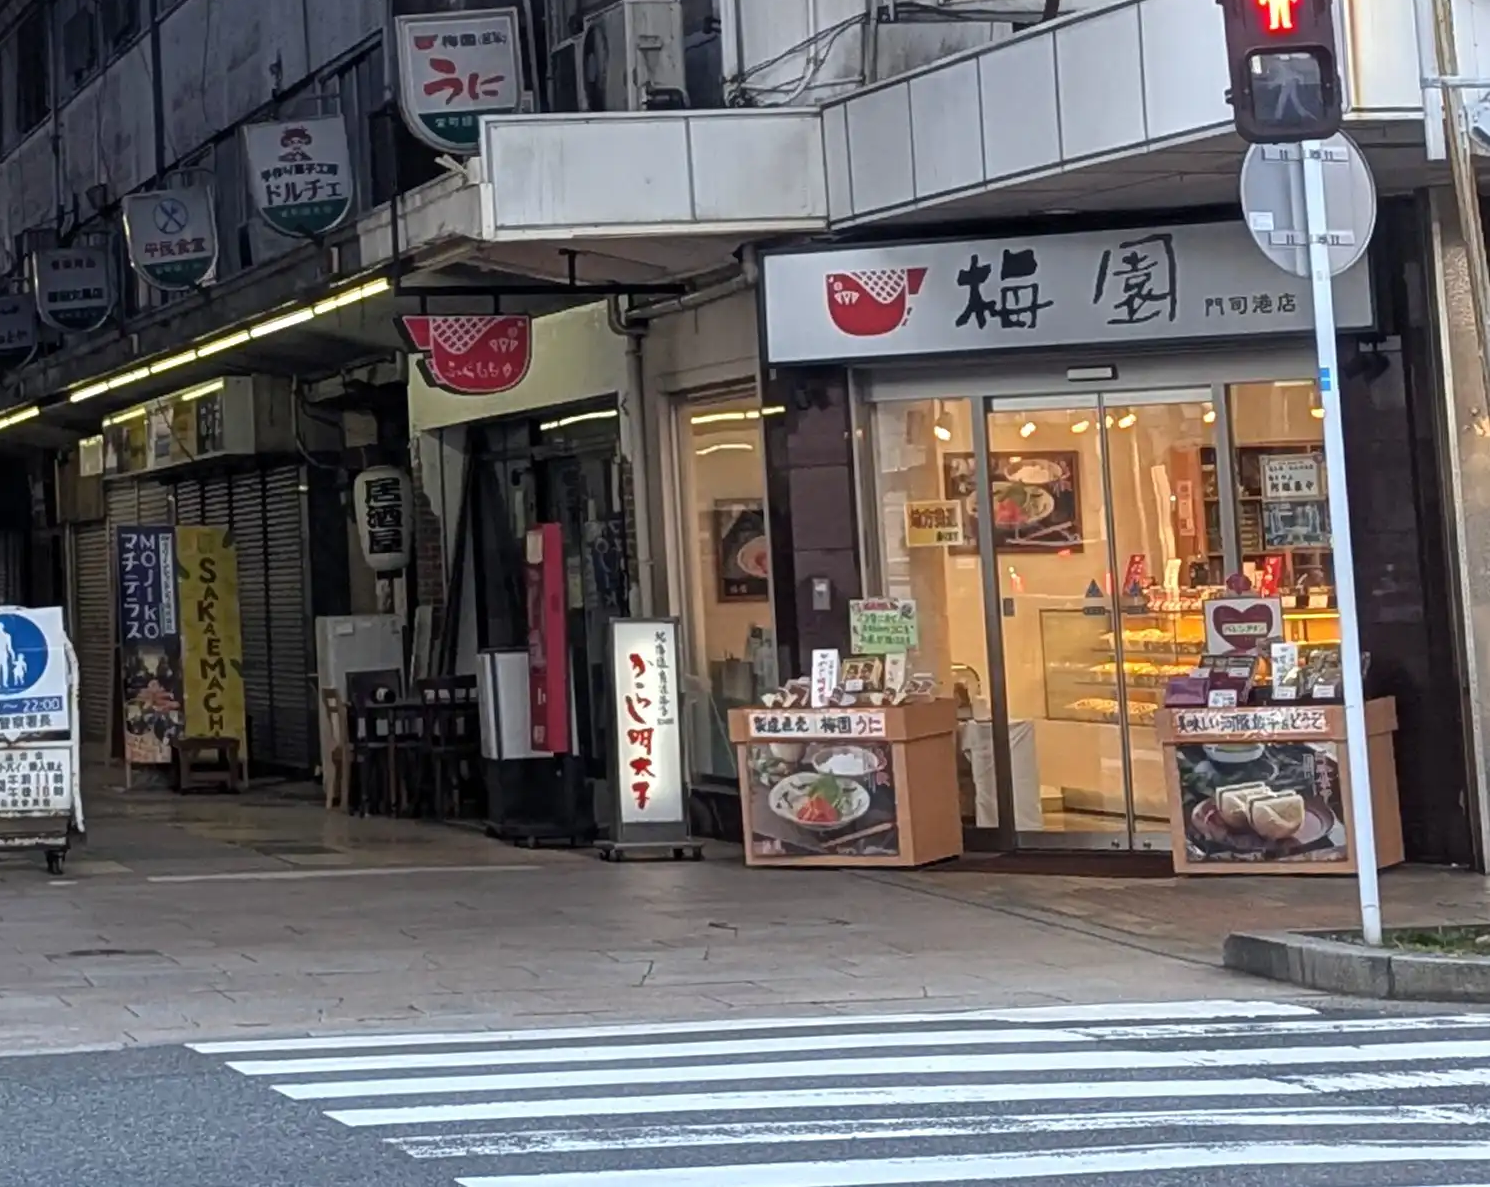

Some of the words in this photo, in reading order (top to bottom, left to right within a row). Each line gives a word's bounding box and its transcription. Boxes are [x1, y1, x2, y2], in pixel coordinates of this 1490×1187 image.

[424, 57, 505, 105] うに
[265, 178, 343, 206] ドルチェ
[955, 234, 1178, 329] 梅園
[1205, 292, 1296, 317] 門司港店
[365, 477, 403, 555] 居酒屋
[120, 533, 143, 639] マチテラス
[139, 533, 160, 640] MOJIKO
